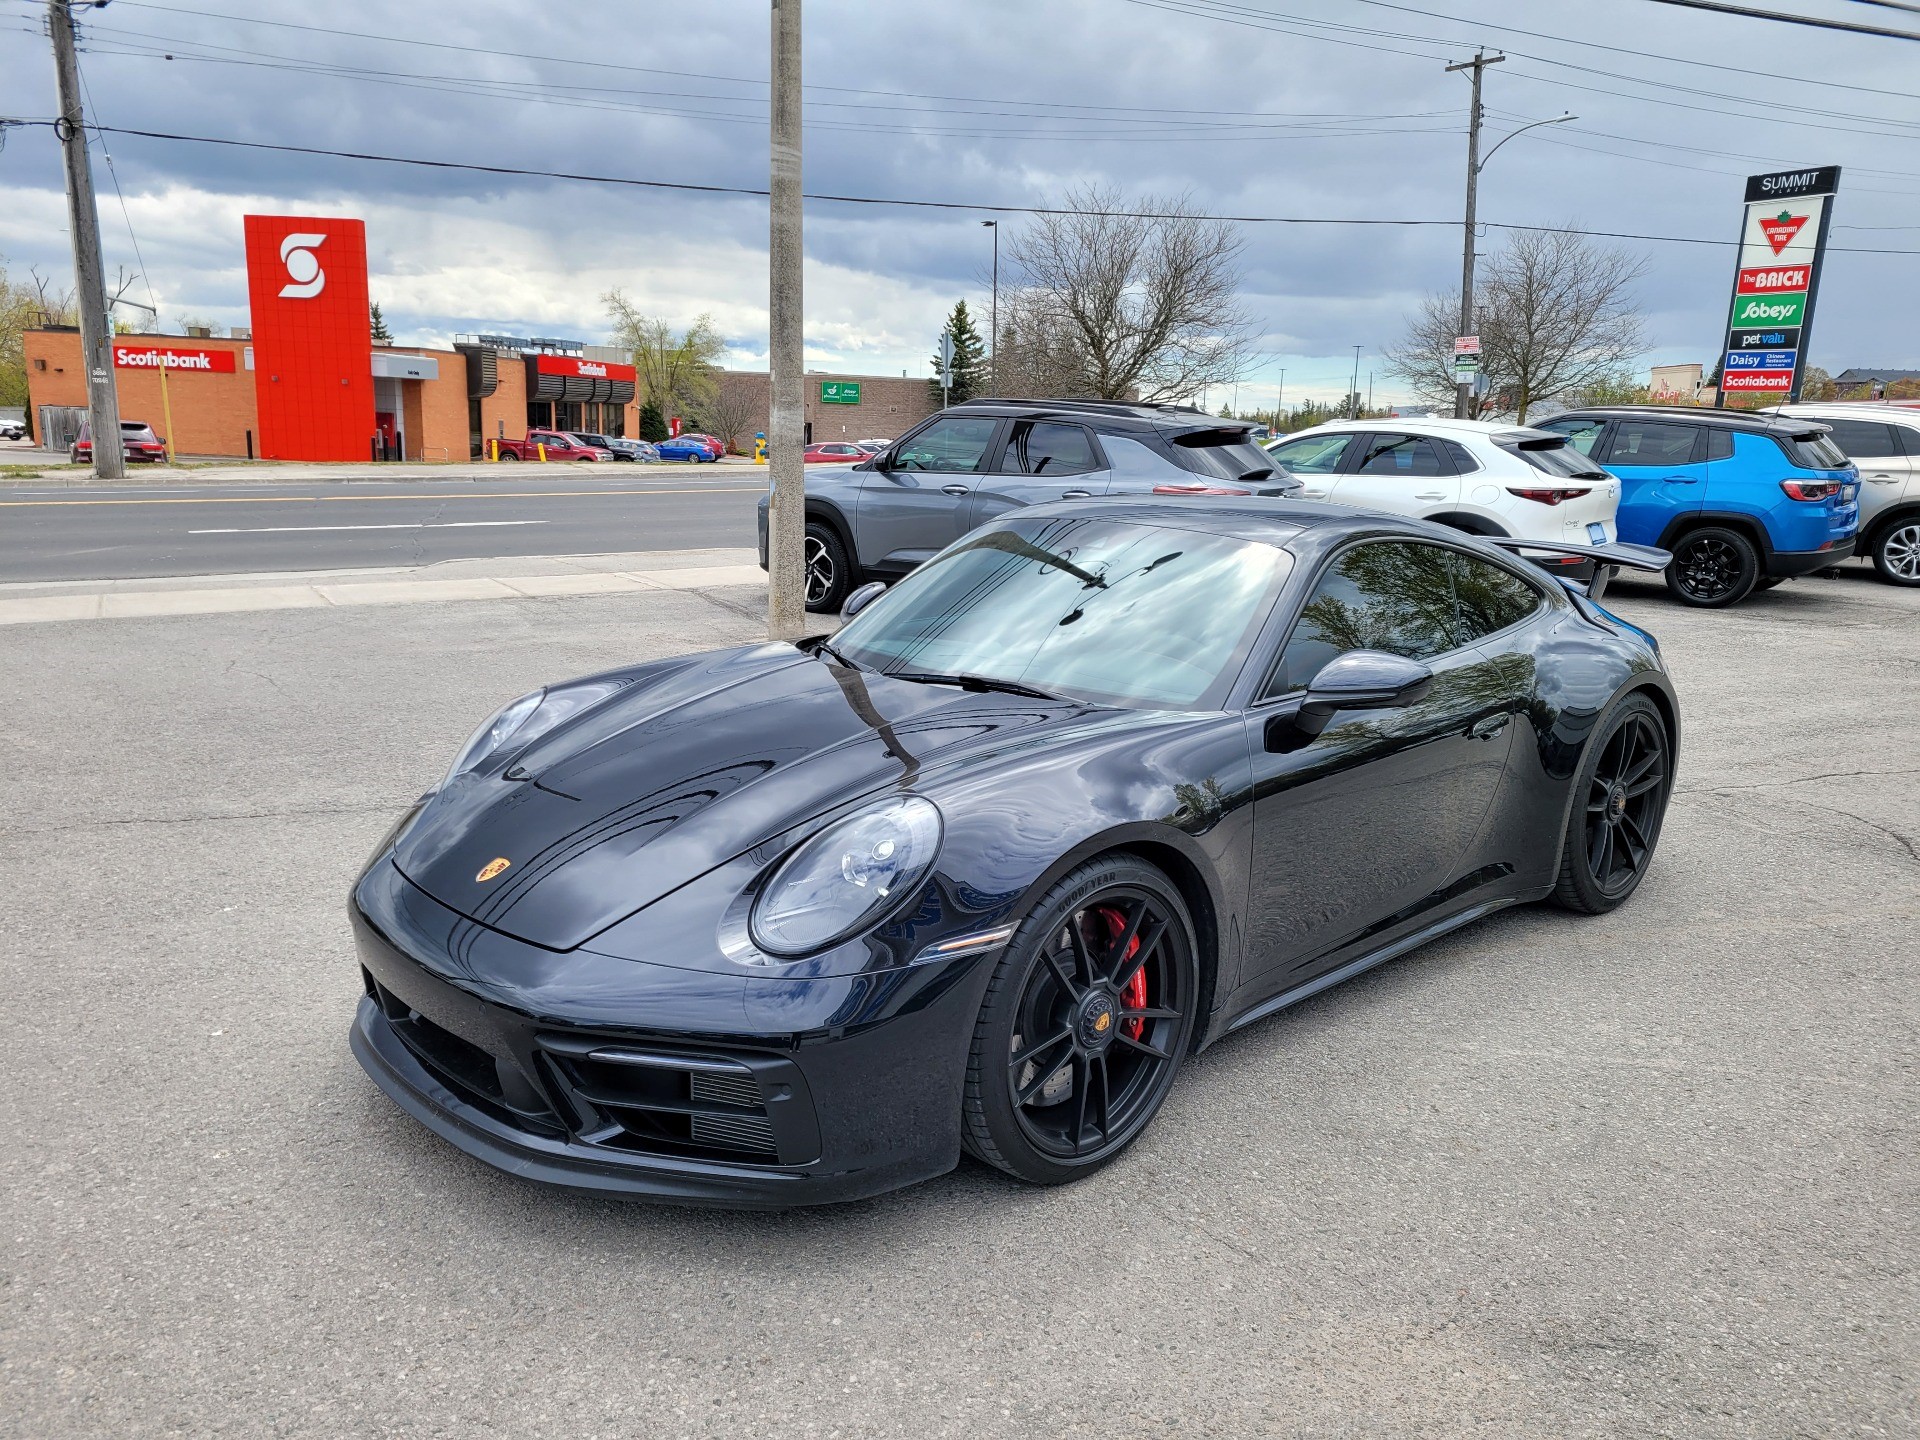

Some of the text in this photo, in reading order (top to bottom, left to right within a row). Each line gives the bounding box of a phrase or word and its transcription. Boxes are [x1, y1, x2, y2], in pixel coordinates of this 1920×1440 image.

[1761, 171, 1819, 191] SUMMIT
[1766, 226, 1798, 235] CANADIAN
[1774, 234, 1788, 242] TIRE
[1743, 270, 1805, 288] The BRICK
[1740, 301, 1797, 321] Sobeys
[1741, 332, 1785, 347] pet valu
[117, 349, 212, 369] Scotiabank
[1730, 354, 1760, 367] Daisy
[1725, 375, 1789, 387] Scotiabank
